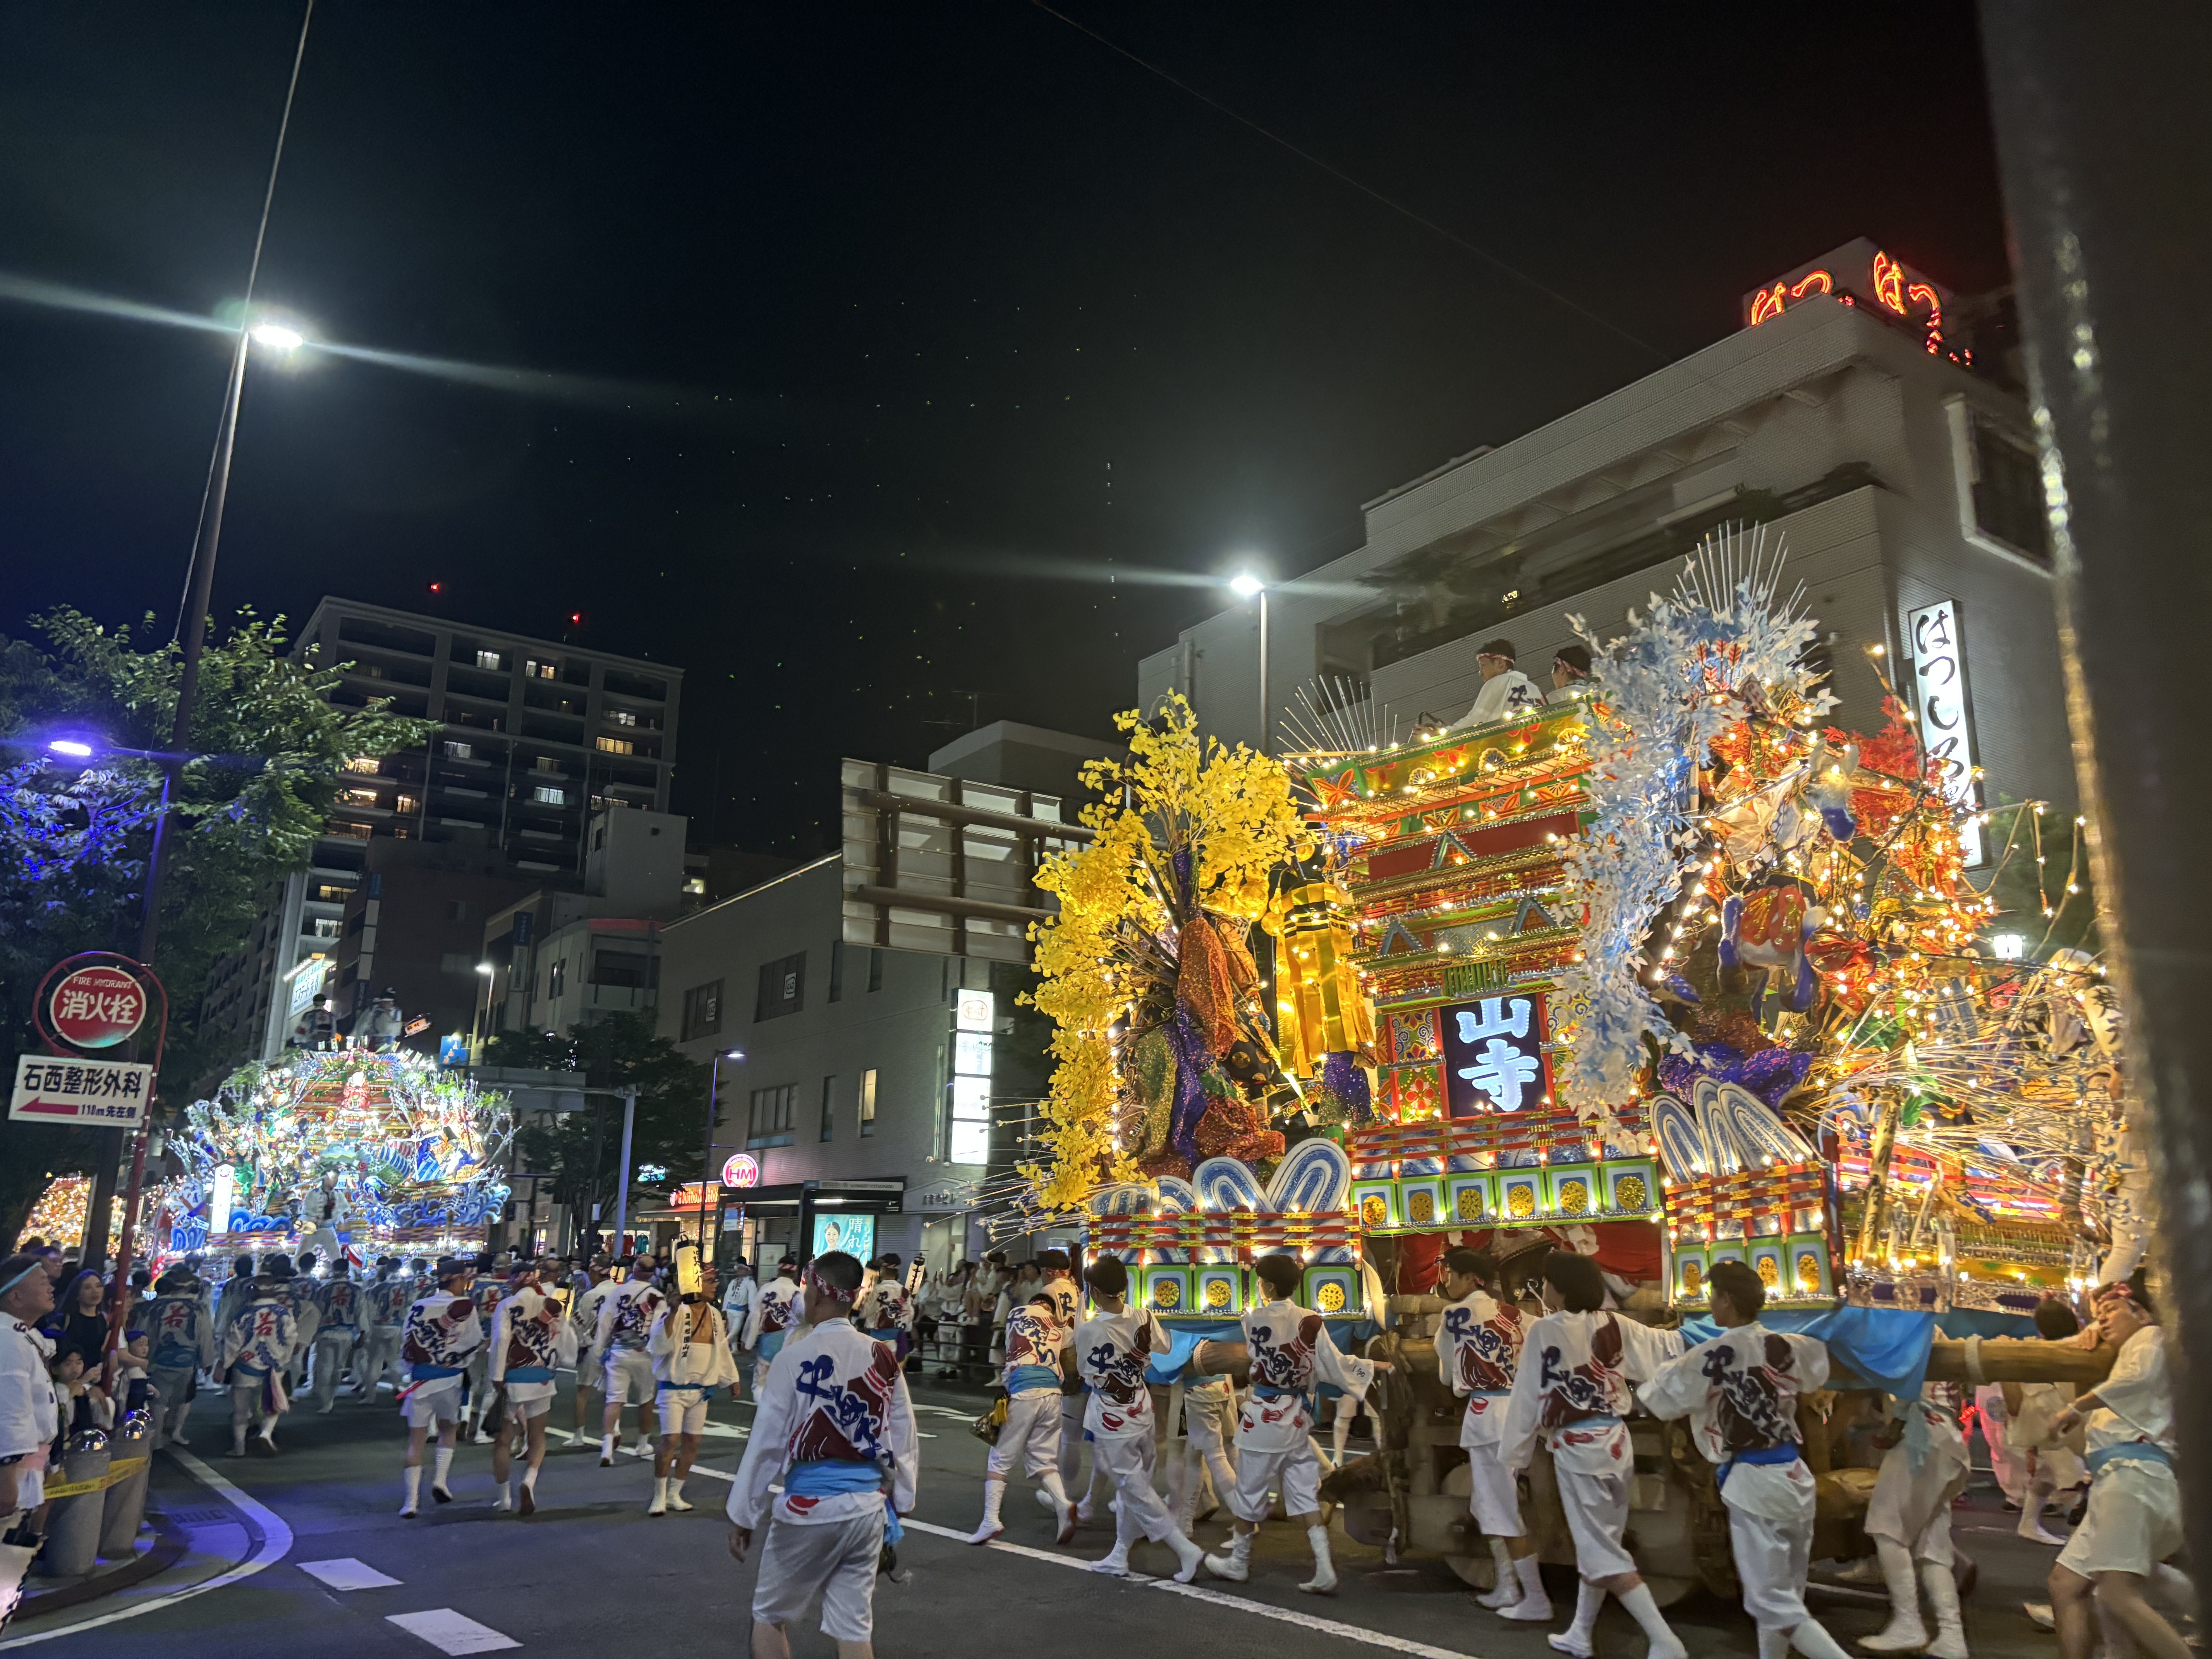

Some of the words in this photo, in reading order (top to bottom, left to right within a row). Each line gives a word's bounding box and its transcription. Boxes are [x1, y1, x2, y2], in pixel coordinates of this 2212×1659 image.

[73, 976, 92, 986] FIRE
[59, 989, 138, 1024] 消火栓
[1456, 997, 1539, 1112] 山寺
[23, 1064, 142, 1099] 石西整形外科
[729, 1169, 752, 1180] HM
[163, 1303, 187, 1328] 若
[255, 1311, 277, 1336] 若
